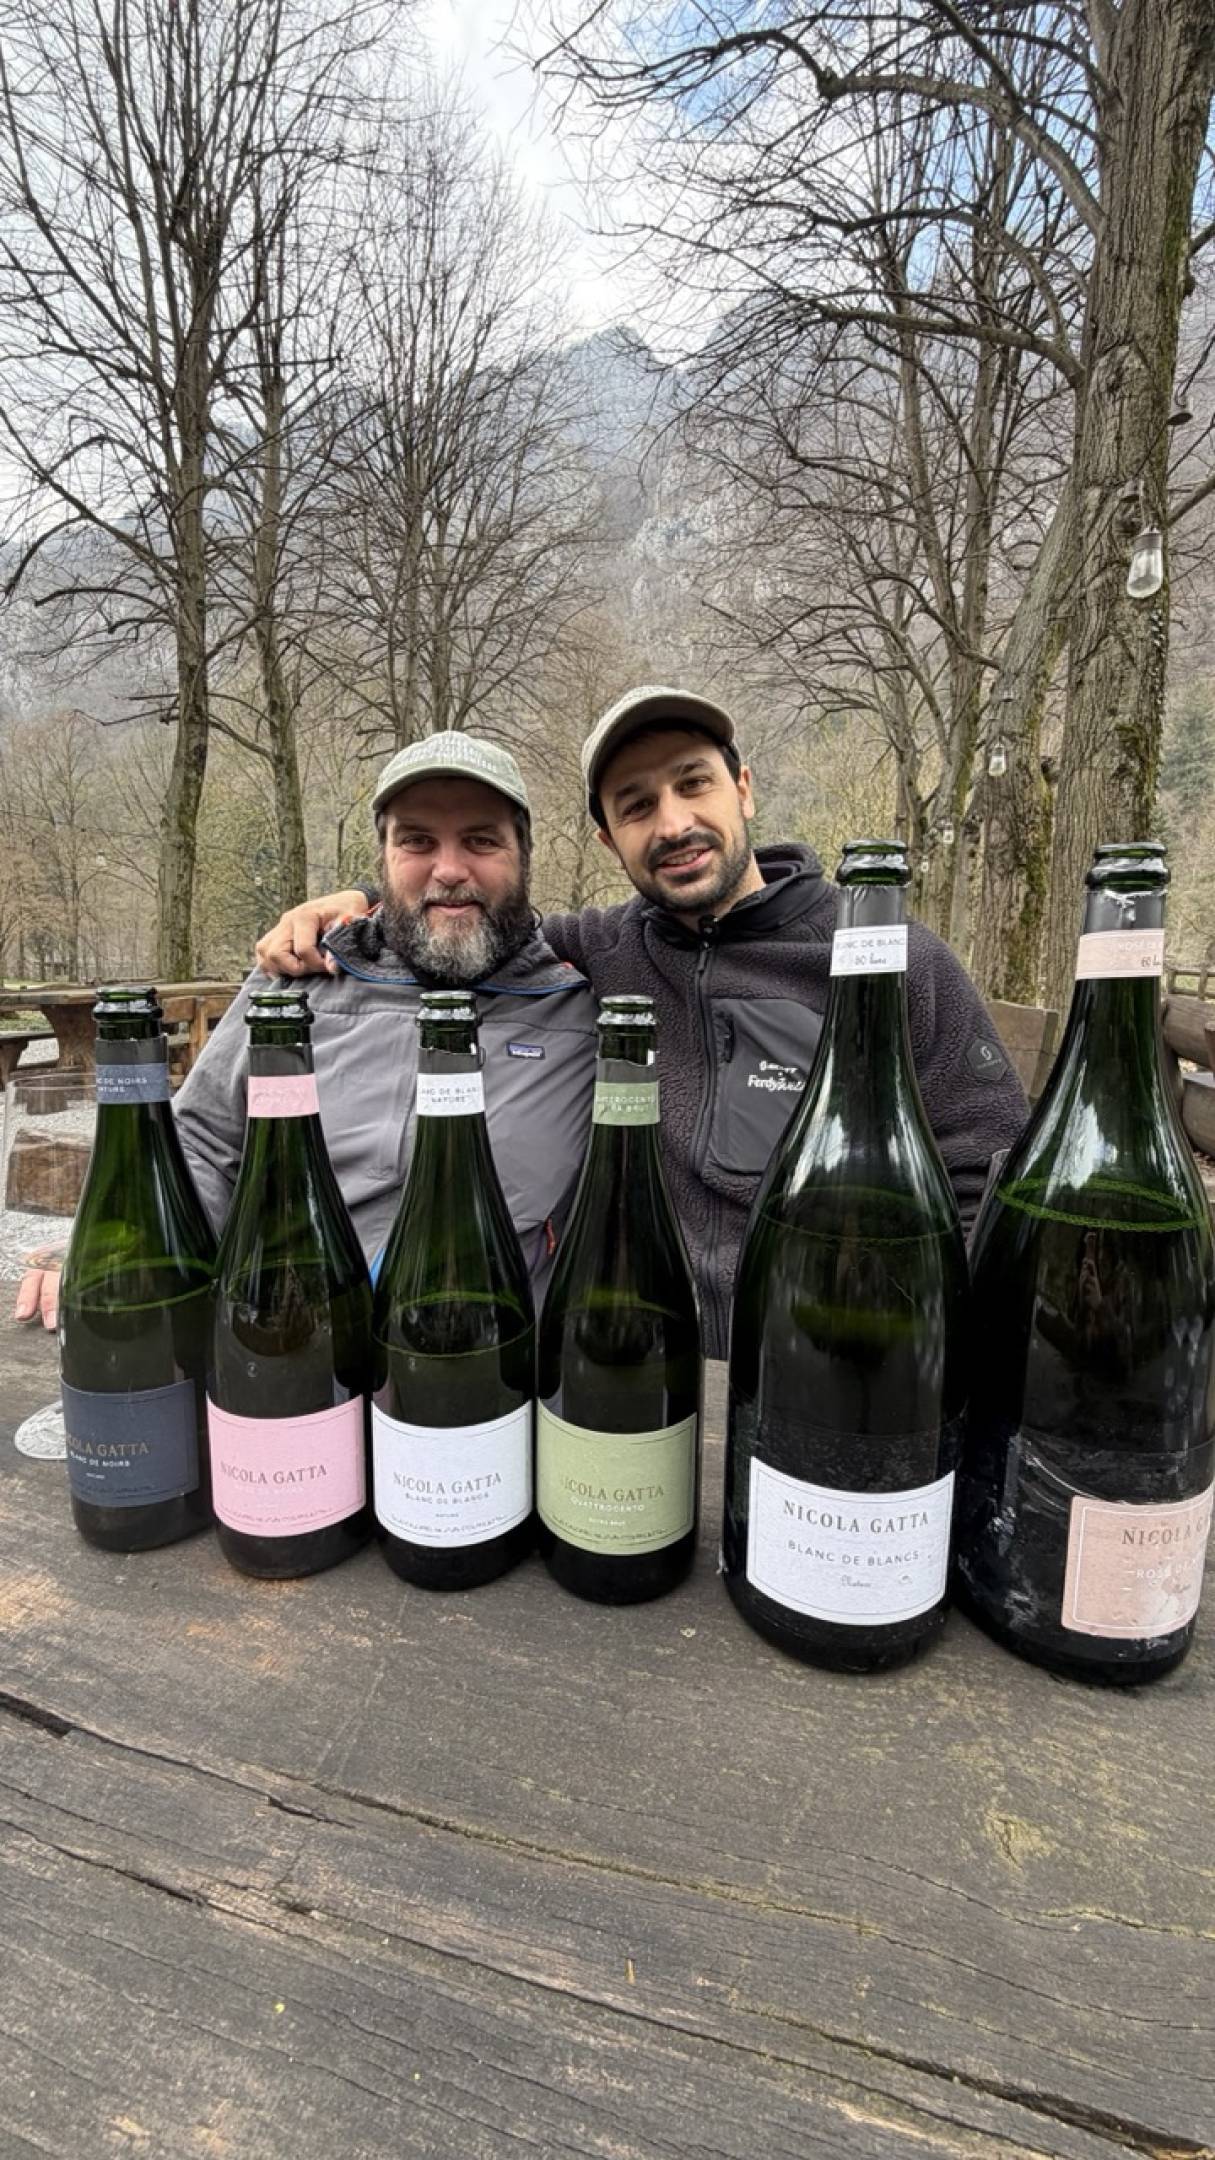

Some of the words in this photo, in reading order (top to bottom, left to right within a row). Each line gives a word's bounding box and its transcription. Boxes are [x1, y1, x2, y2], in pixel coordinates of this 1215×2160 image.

[861, 940, 875, 948] DE
[117, 1076, 148, 1085] NOIRS
[97, 1441, 150, 1457] GATTA
[89, 1458, 100, 1467] DE
[102, 1459, 130, 1468] NOIRS
[220, 1461, 268, 1485] NICOLA
[272, 1464, 327, 1485] GATTA
[393, 1471, 446, 1495] NICOLA
[451, 1472, 502, 1495] GATTA
[405, 1492, 433, 1505] BLANC
[436, 1497, 448, 1505] DE
[453, 1492, 490, 1505] BLANCS
[613, 1485, 664, 1501] GATTA
[570, 1496, 646, 1513] QUATTROCENTO
[783, 1500, 860, 1533] NICOLA
[870, 1512, 929, 1534] GATTA
[1121, 1524, 1192, 1546] NICOLA
[788, 1540, 835, 1562] BLANC
[841, 1555, 861, 1566] DE
[867, 1551, 919, 1567] BLANCS
